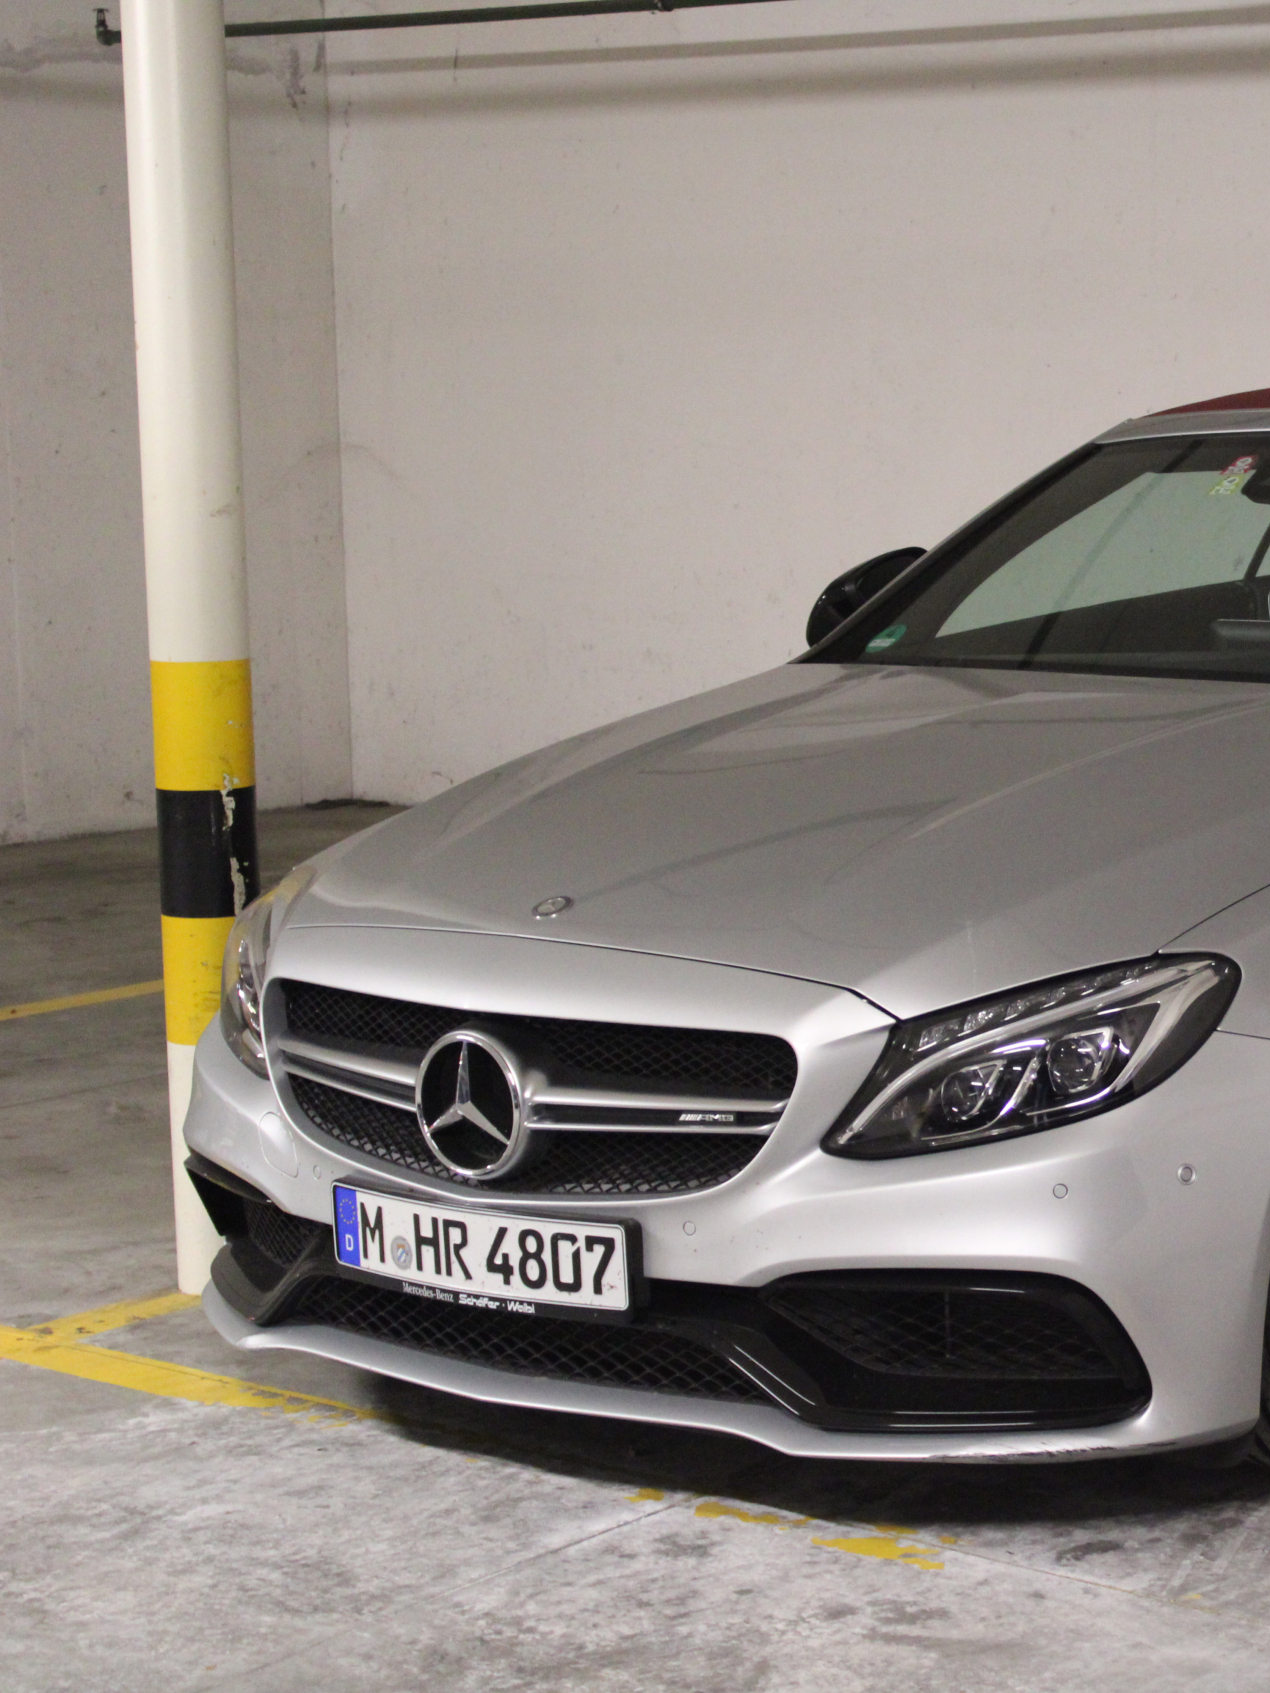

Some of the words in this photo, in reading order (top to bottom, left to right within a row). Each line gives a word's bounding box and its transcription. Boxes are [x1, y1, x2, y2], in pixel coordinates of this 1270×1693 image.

[699, 1113, 734, 1122] AMG
[345, 1233, 354, 1252] D
[359, 1201, 386, 1264] M
[413, 1213, 473, 1280] HR
[486, 1226, 616, 1295] 4807
[402, 1281, 454, 1303] Mercedes-Benz
